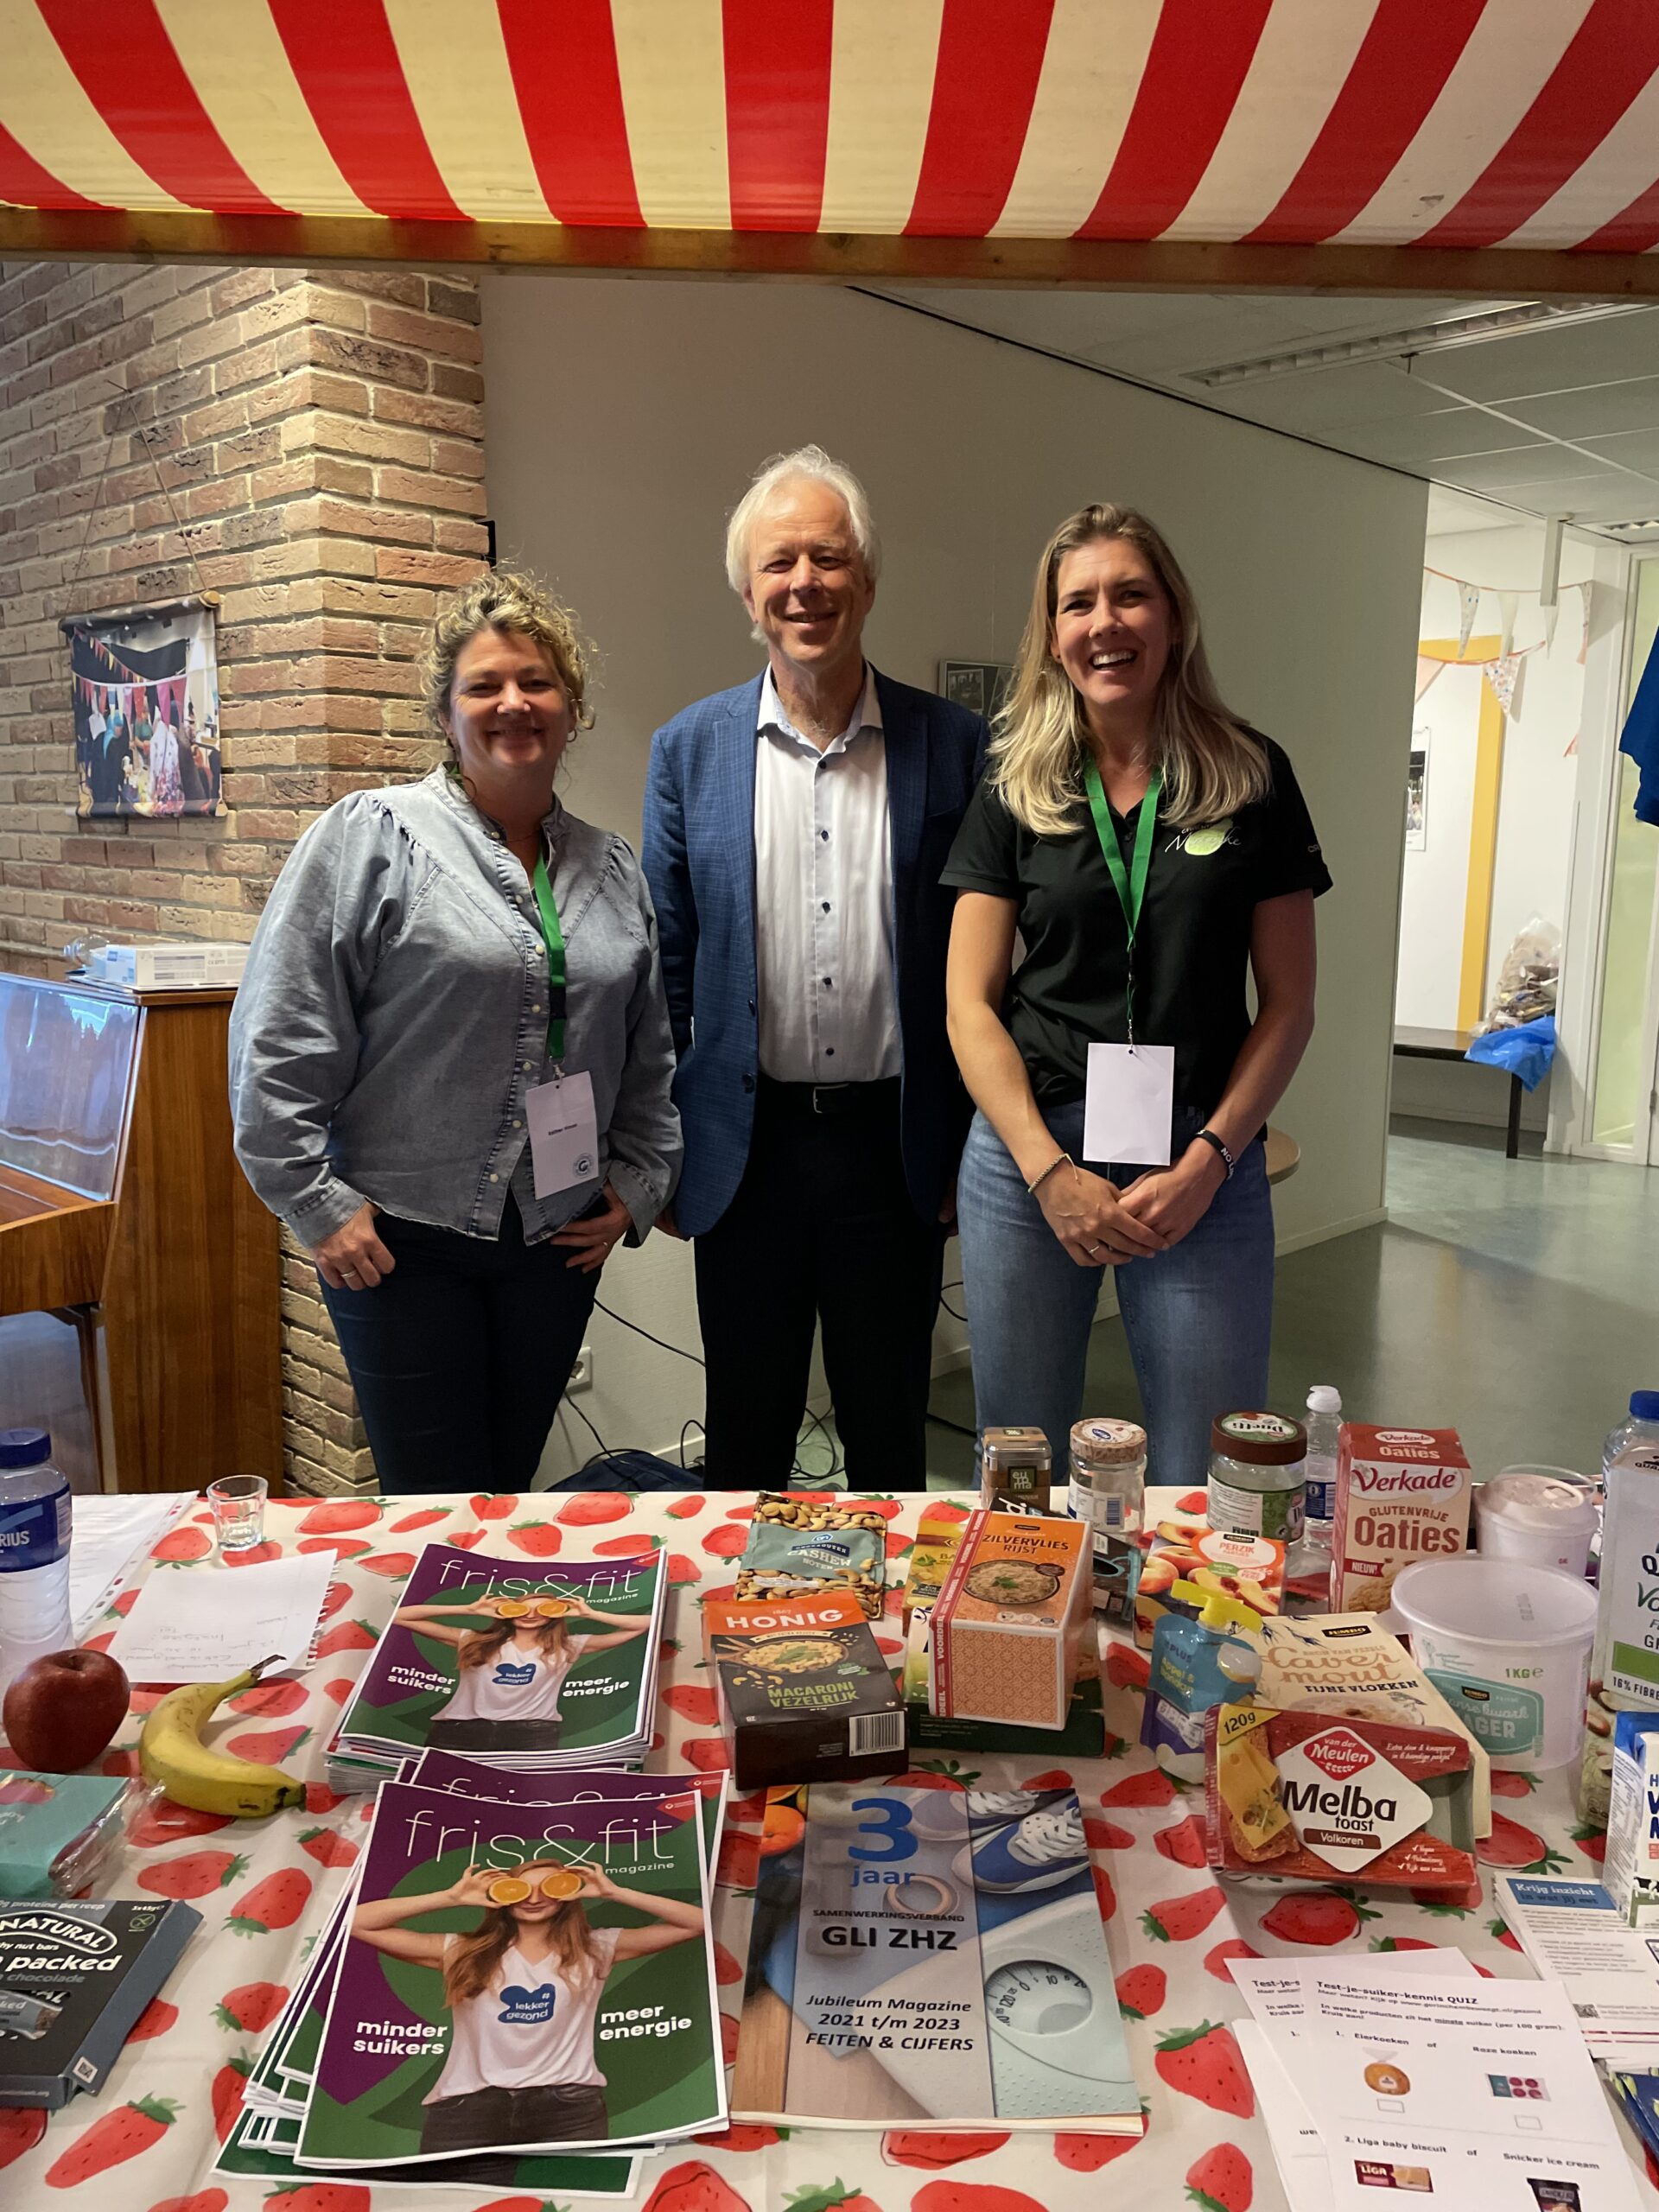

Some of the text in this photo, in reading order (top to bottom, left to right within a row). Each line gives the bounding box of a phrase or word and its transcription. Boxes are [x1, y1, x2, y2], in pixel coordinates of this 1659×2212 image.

[1381, 1433, 1431, 1442] Verkade
[1379, 1446, 1441, 1460] Oaties
[1635, 1462, 1659, 1471] QUA
[1351, 1467, 1457, 1492] Verkade
[1369, 1505, 1449, 1523] GLUTENVRIJE
[982, 1534, 1070, 1551] ZILVERVLIES
[1354, 1516, 1460, 1554] Oaties
[1002, 1543, 1038, 1555] RIJST
[1218, 1541, 1255, 1555] PERZIK
[787, 1548, 852, 1567] CASHEW
[802, 1557, 834, 1570] NOTEN
[1351, 1561, 1378, 1575] NIEUW!
[439, 1559, 643, 1599] fris&fit
[585, 1592, 639, 1605] magazine
[725, 1609, 844, 1630] HONIG
[936, 1614, 946, 1660] VOORDEEL
[1327, 1627, 1367, 1637] JUMBO
[1169, 1645, 1192, 1663] PLUS
[390, 1665, 456, 1686] minder
[564, 1675, 613, 1688] meer
[1504, 1667, 1530, 1679] 1 KG
[386, 1674, 452, 1695] suikers
[562, 1680, 631, 1698] energie
[766, 1681, 855, 1699] MACARONI
[1304, 1680, 1420, 1694] FIJNE VLOKKEN
[1612, 1675, 1631, 1691] 16%
[769, 1690, 860, 1708] VEZELRIJK
[1224, 1712, 1256, 1735] 120g
[1323, 1737, 1358, 1748] van der
[1309, 1744, 1370, 1764] Meulen
[1282, 1780, 1397, 1822] Melba
[848, 1797, 919, 1862] 3
[1335, 1815, 1375, 1832] toast
[405, 1809, 674, 1871] fris&fit
[1319, 1831, 1364, 1847] Volkoren
[605, 1860, 676, 1875] magazine
[850, 1865, 916, 1888] jaar
[1515, 1883, 1596, 1897] Krijg inzicht
[58, 1902, 79, 1910] per
[812, 1909, 965, 1923] SAMENWERKINGSVERBAND
[0, 1916, 106, 1948] NATURAL
[822, 1926, 958, 1951] GLI ZHZ
[4, 1954, 124, 1973] packed
[6, 1973, 86, 1983] chocolade
[1019, 1981, 1031, 1992] 0
[1045, 1974, 1058, 1986] 10
[998, 1994, 1016, 2008] 120
[1316, 1980, 1479, 2005] Test-je-suiker-kennis QUIZ
[515, 1999, 550, 2011] lekker
[805, 1994, 972, 2013] Jubileum Magazine
[505, 2008, 549, 2022] gezond
[601, 2004, 664, 2024] meer
[817, 2013, 961, 2031] 2021 t/m 2023
[1359, 2010, 1402, 2019] producten
[1495, 2021, 1514, 2030] (per
[355, 2019, 448, 2038] minder
[598, 2016, 692, 2042] energie
[352, 2037, 445, 2056] suikers
[805, 2032, 974, 2051] FEITEN & CIJFERS
[1353, 2032, 1409, 2046] Eierkoeken
[1499, 2048, 1537, 2057] koeken
[1344, 2135, 1600, 2171] 2. Liga baby biscuit of Snicker ice cream
